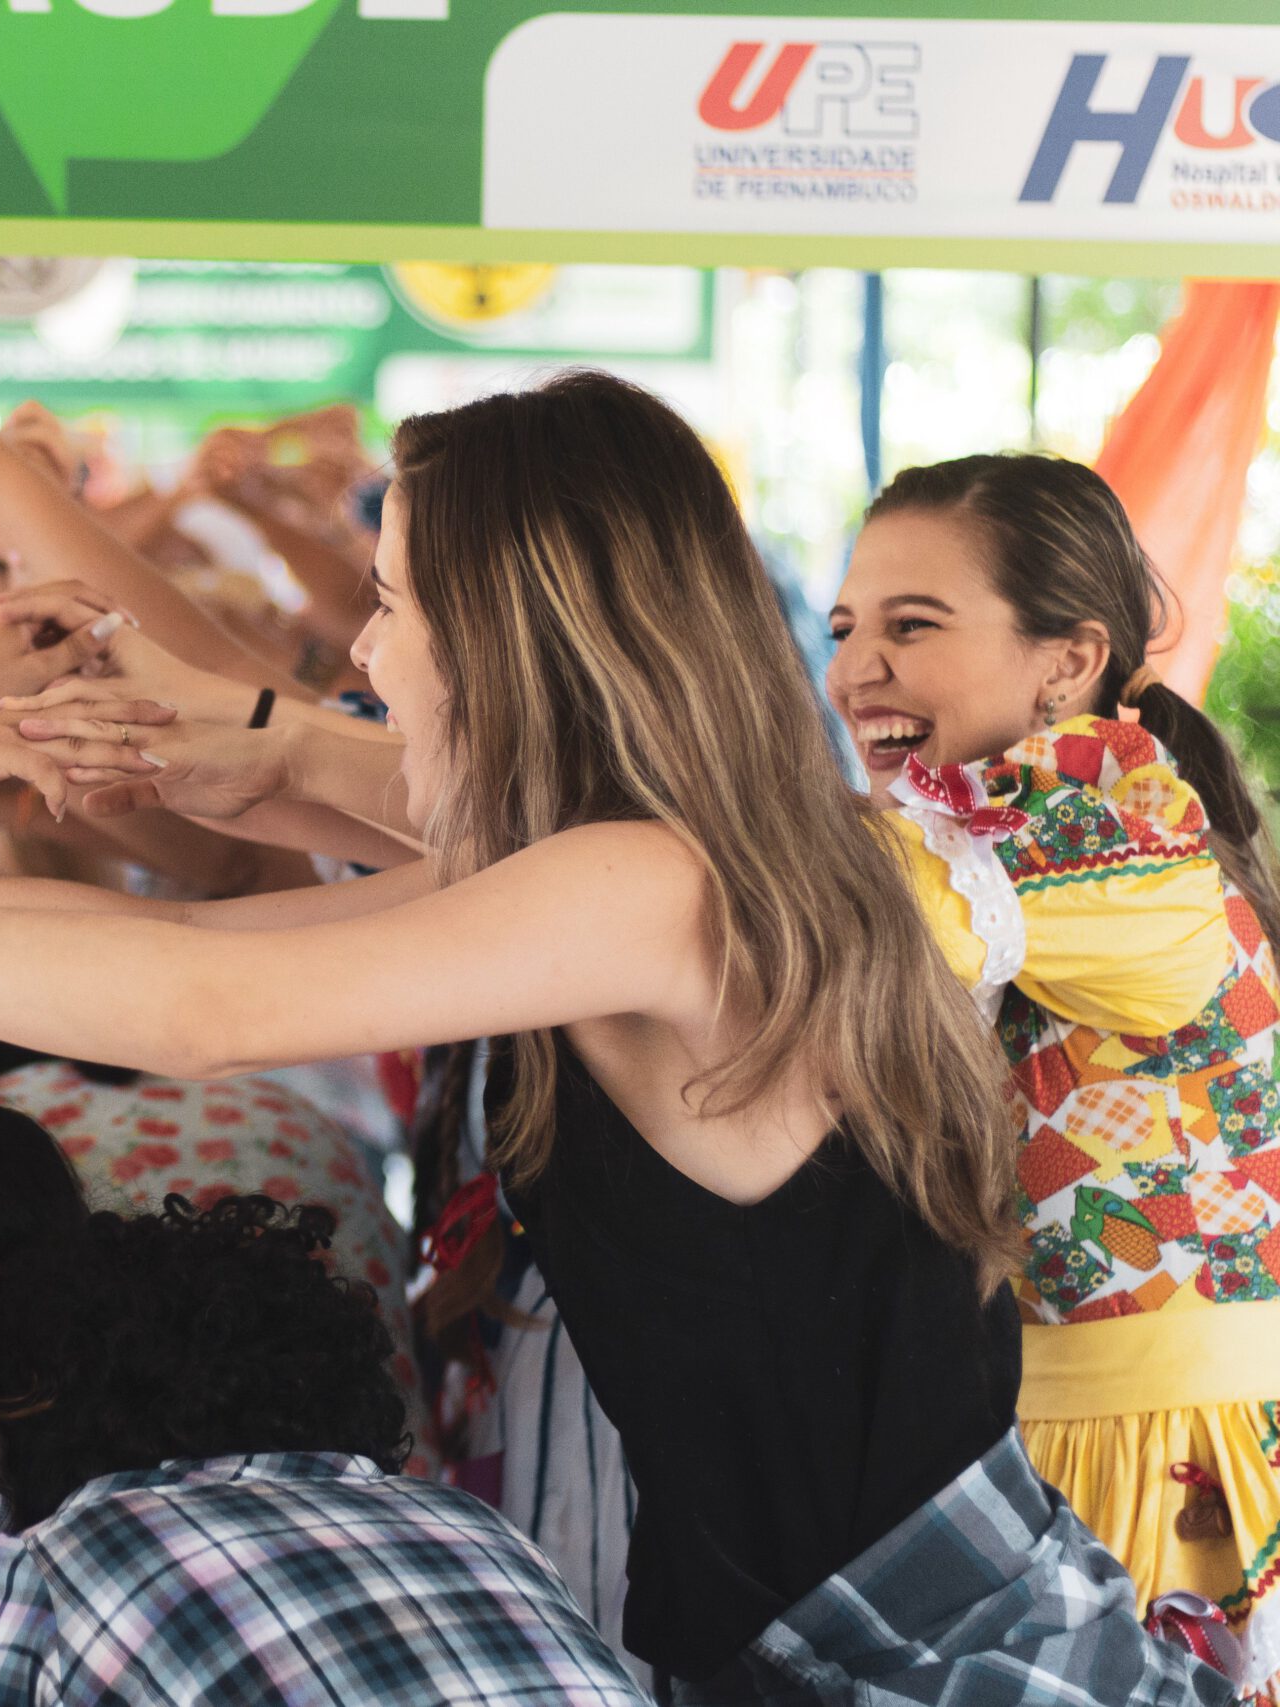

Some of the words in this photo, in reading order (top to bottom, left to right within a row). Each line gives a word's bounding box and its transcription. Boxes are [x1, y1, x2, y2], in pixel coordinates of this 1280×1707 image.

[696, 40, 921, 139] UPE
[695, 144, 915, 168] UNIVERSIDADE
[1171, 160, 1266, 186] Hospital
[696, 179, 725, 199] DE
[737, 179, 917, 201] PERNAMBUCO
